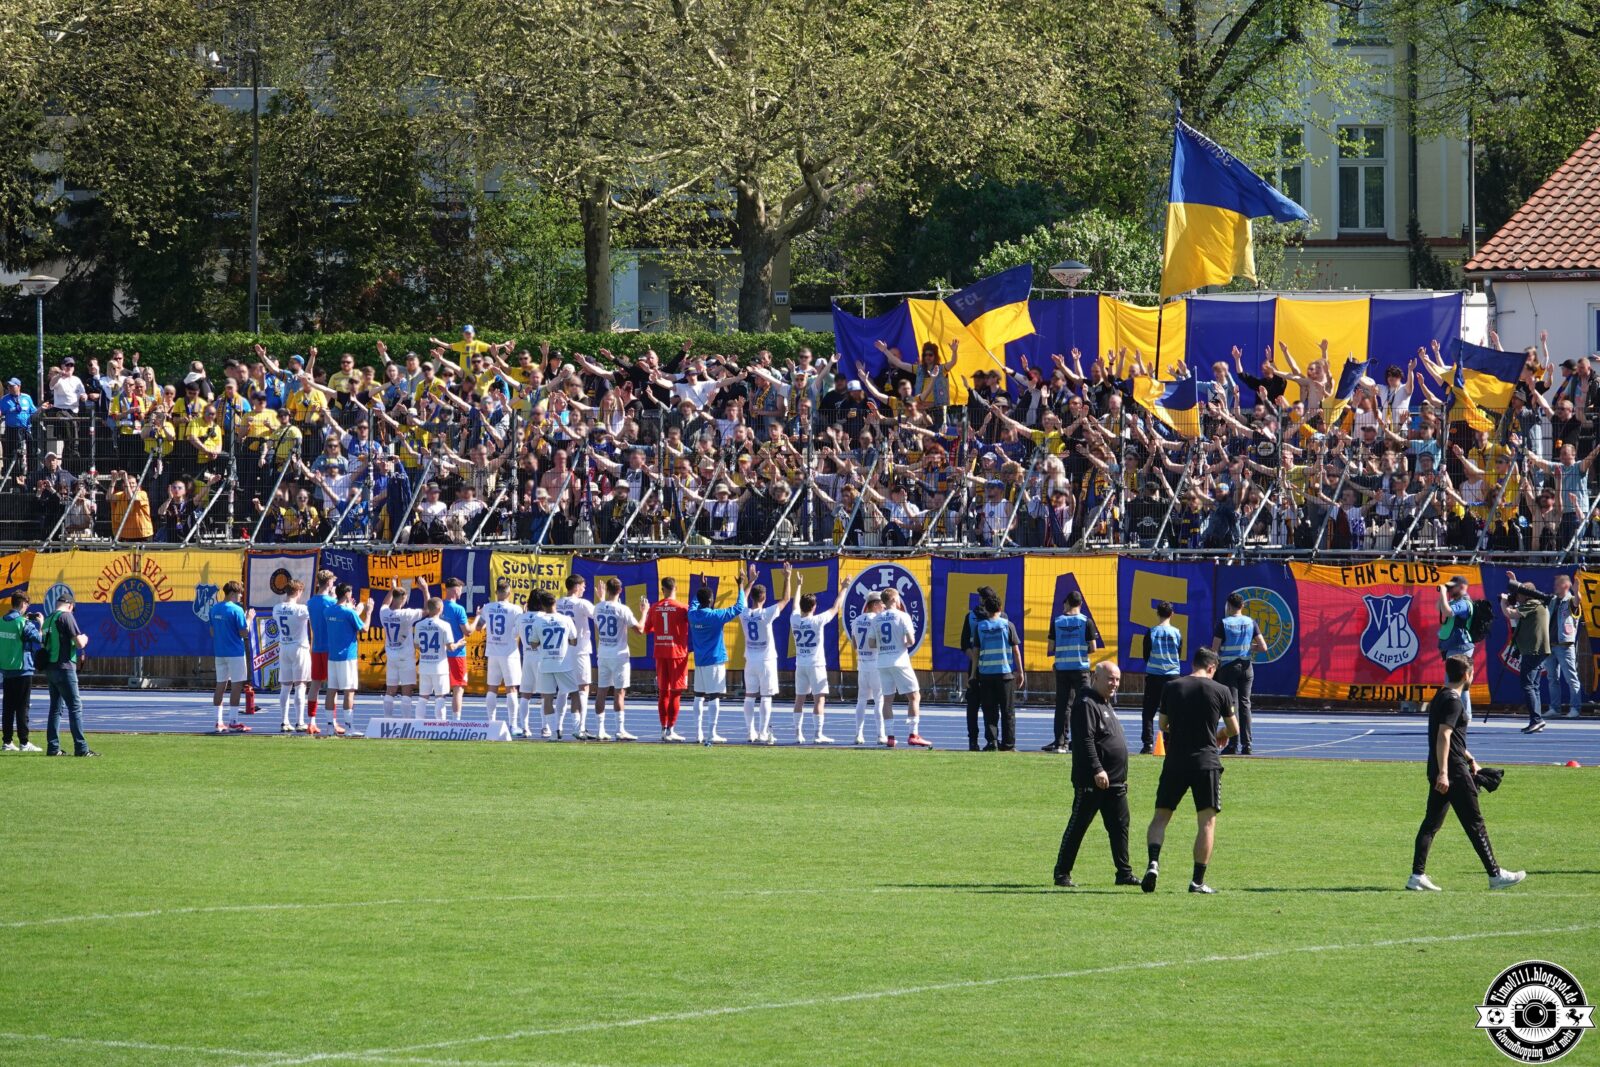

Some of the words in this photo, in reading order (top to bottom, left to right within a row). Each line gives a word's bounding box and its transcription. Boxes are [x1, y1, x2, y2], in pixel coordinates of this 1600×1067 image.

[325, 552, 354, 571] SUPER
[372, 550, 440, 569] FAN-CLUB
[502, 561, 564, 576] SÜDWEST
[540, 580, 559, 590] DEN
[279, 616, 290, 637] 5
[384, 623, 401, 643] 17
[488, 614, 506, 636] 13
[597, 615, 618, 637] 28
[662, 612, 669, 635] 1
[748, 622, 759, 641] 8
[881, 623, 892, 644] 9
[1367, 599, 1411, 649] VfB
[418, 632, 440, 654] 34
[542, 628, 566, 650] 27
[793, 630, 817, 648] 22
[857, 628, 868, 650] 7
[1373, 650, 1410, 664] LEIPZIG
